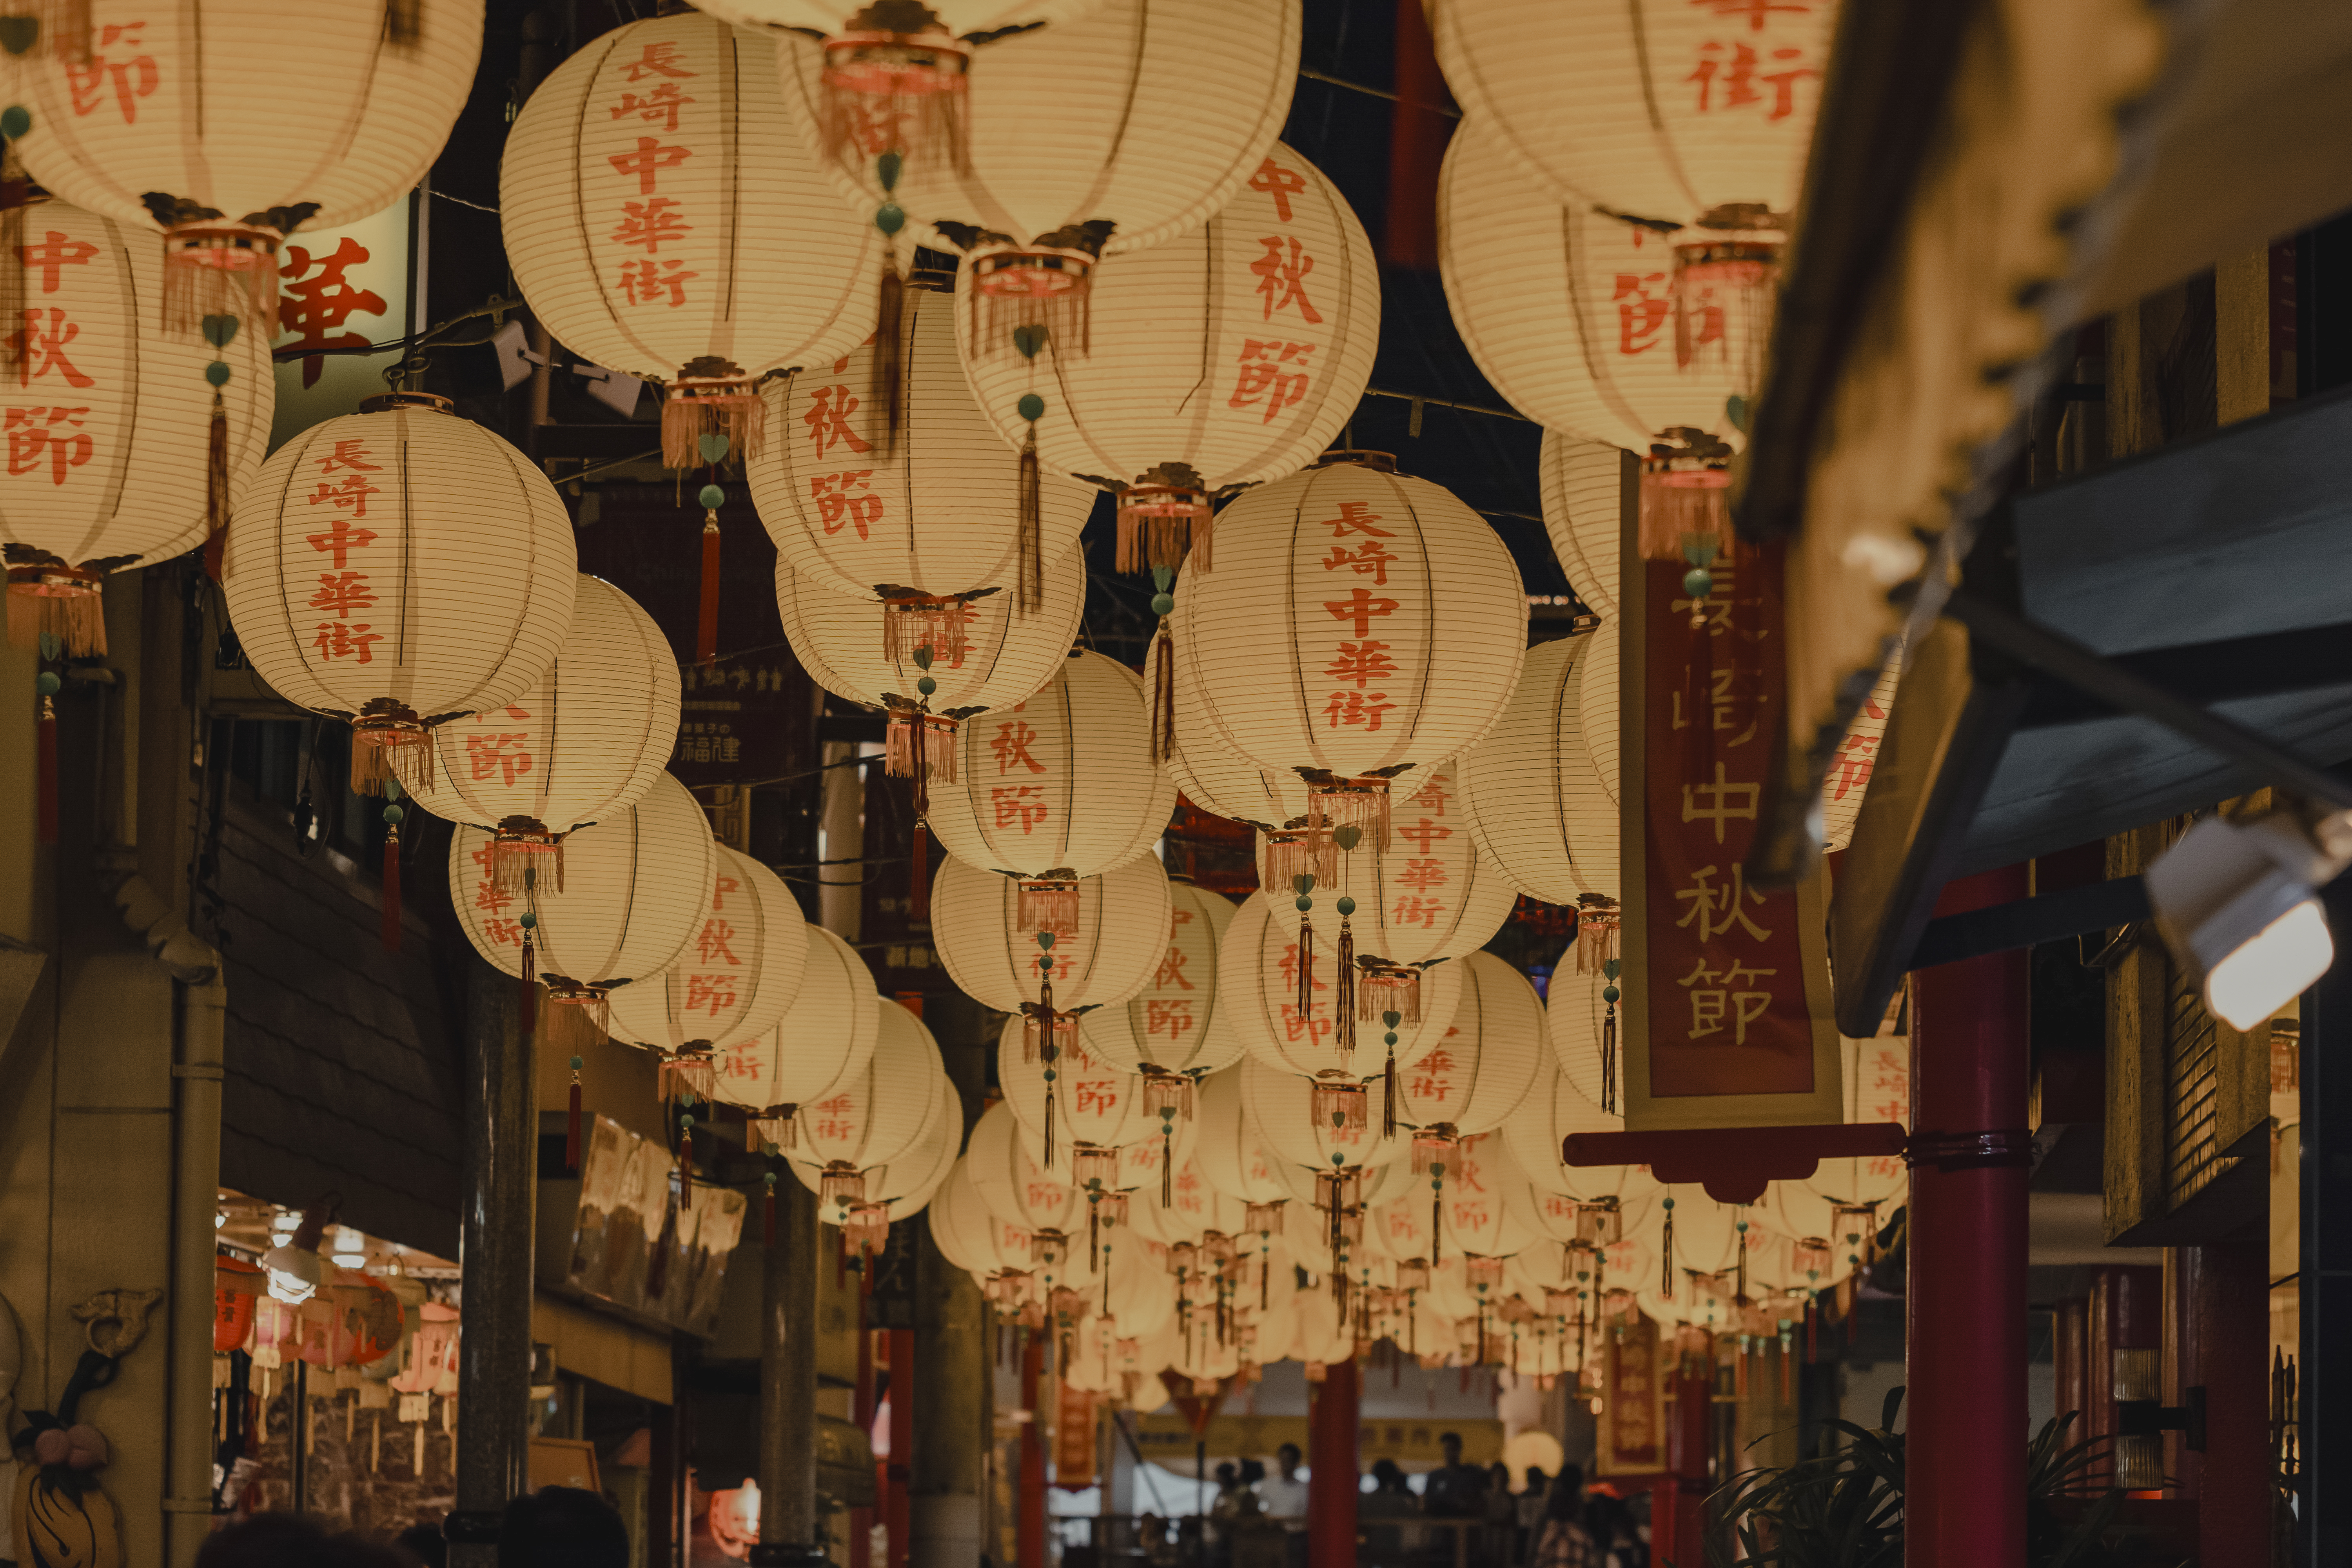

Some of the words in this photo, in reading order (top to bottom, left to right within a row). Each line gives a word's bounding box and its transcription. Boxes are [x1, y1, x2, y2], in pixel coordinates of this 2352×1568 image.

[608, 41, 700, 308] 長崎中華街
[3, 230, 100, 486] 中秋節
[273, 237, 387, 389] 華
[1228, 158, 1323, 425] 中秋節
[1612, 224, 1725, 369] 節
[804, 332, 884, 541] 秋節
[307, 439, 384, 664] 長崎中華街
[1321, 502, 1400, 731] 長崎中華街
[465, 704, 532, 788] 節
[990, 681, 1047, 835] 秋節
